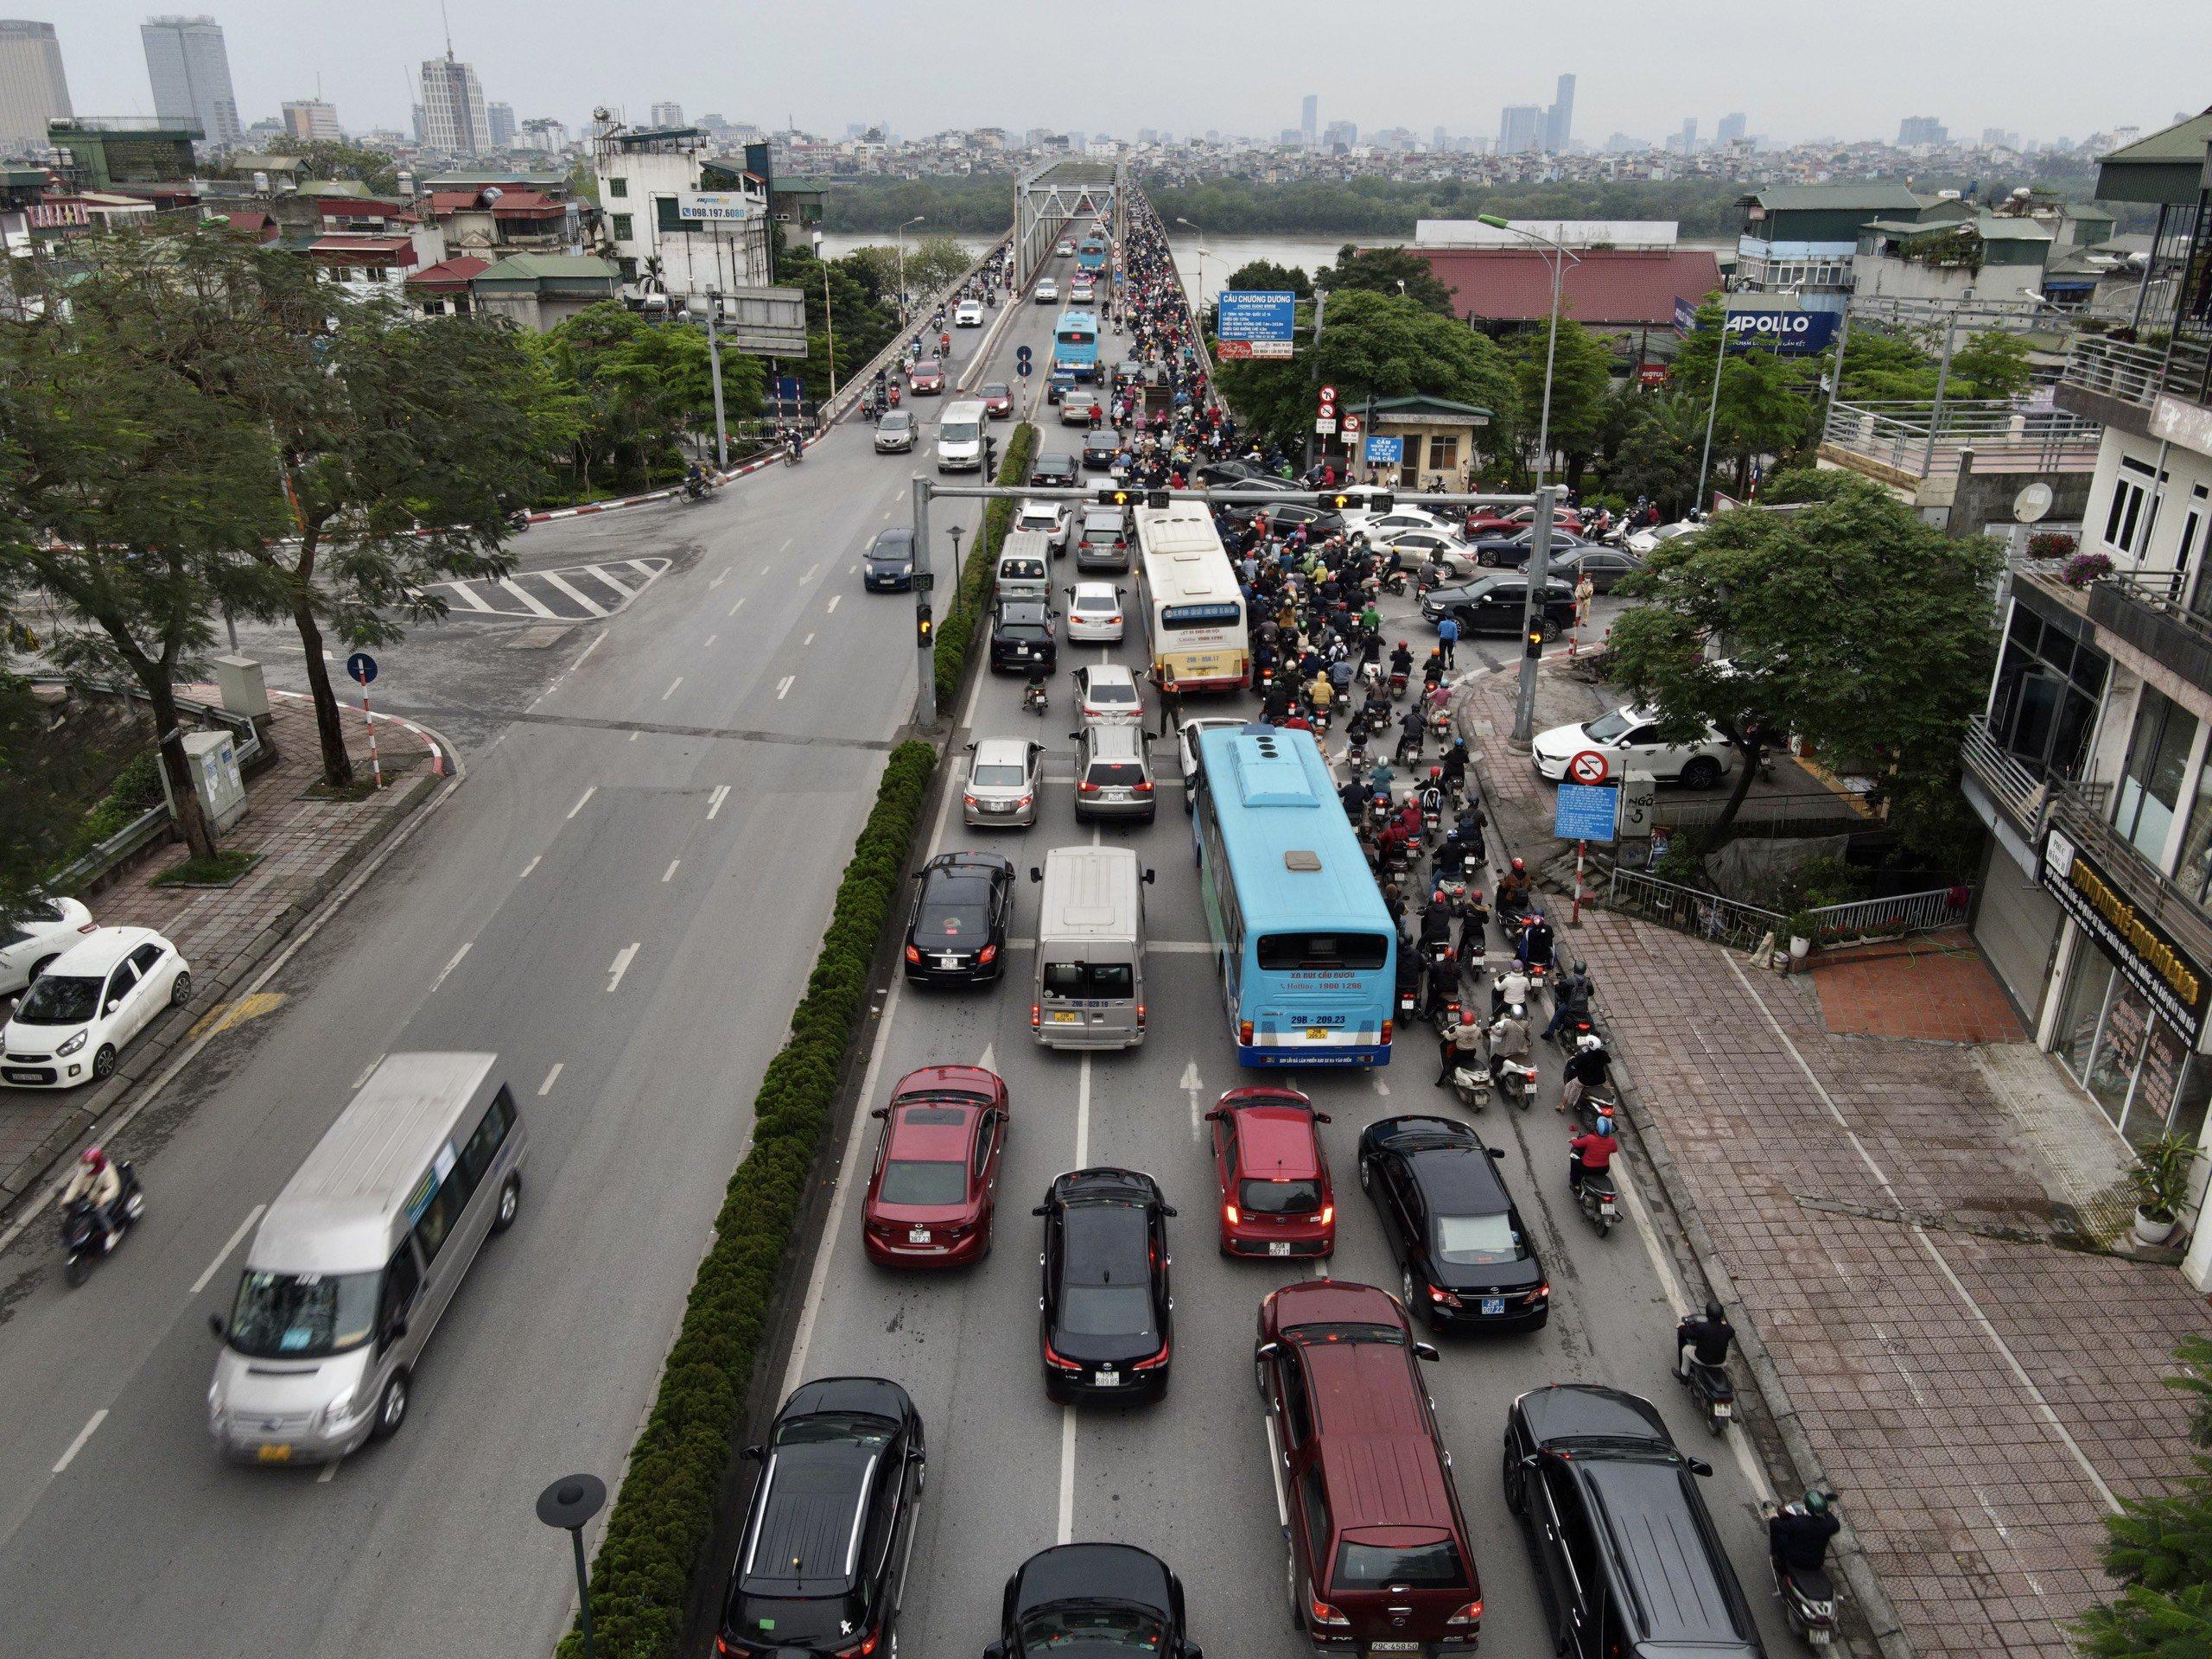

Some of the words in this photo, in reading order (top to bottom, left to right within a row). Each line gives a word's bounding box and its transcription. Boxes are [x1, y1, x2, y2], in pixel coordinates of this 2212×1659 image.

[692, 208, 744, 217] 098.197.6080
[1726, 316, 1809, 332] APOLLO
[1629, 794, 1654, 806] NGÕ
[1632, 810, 1643, 824] 5
